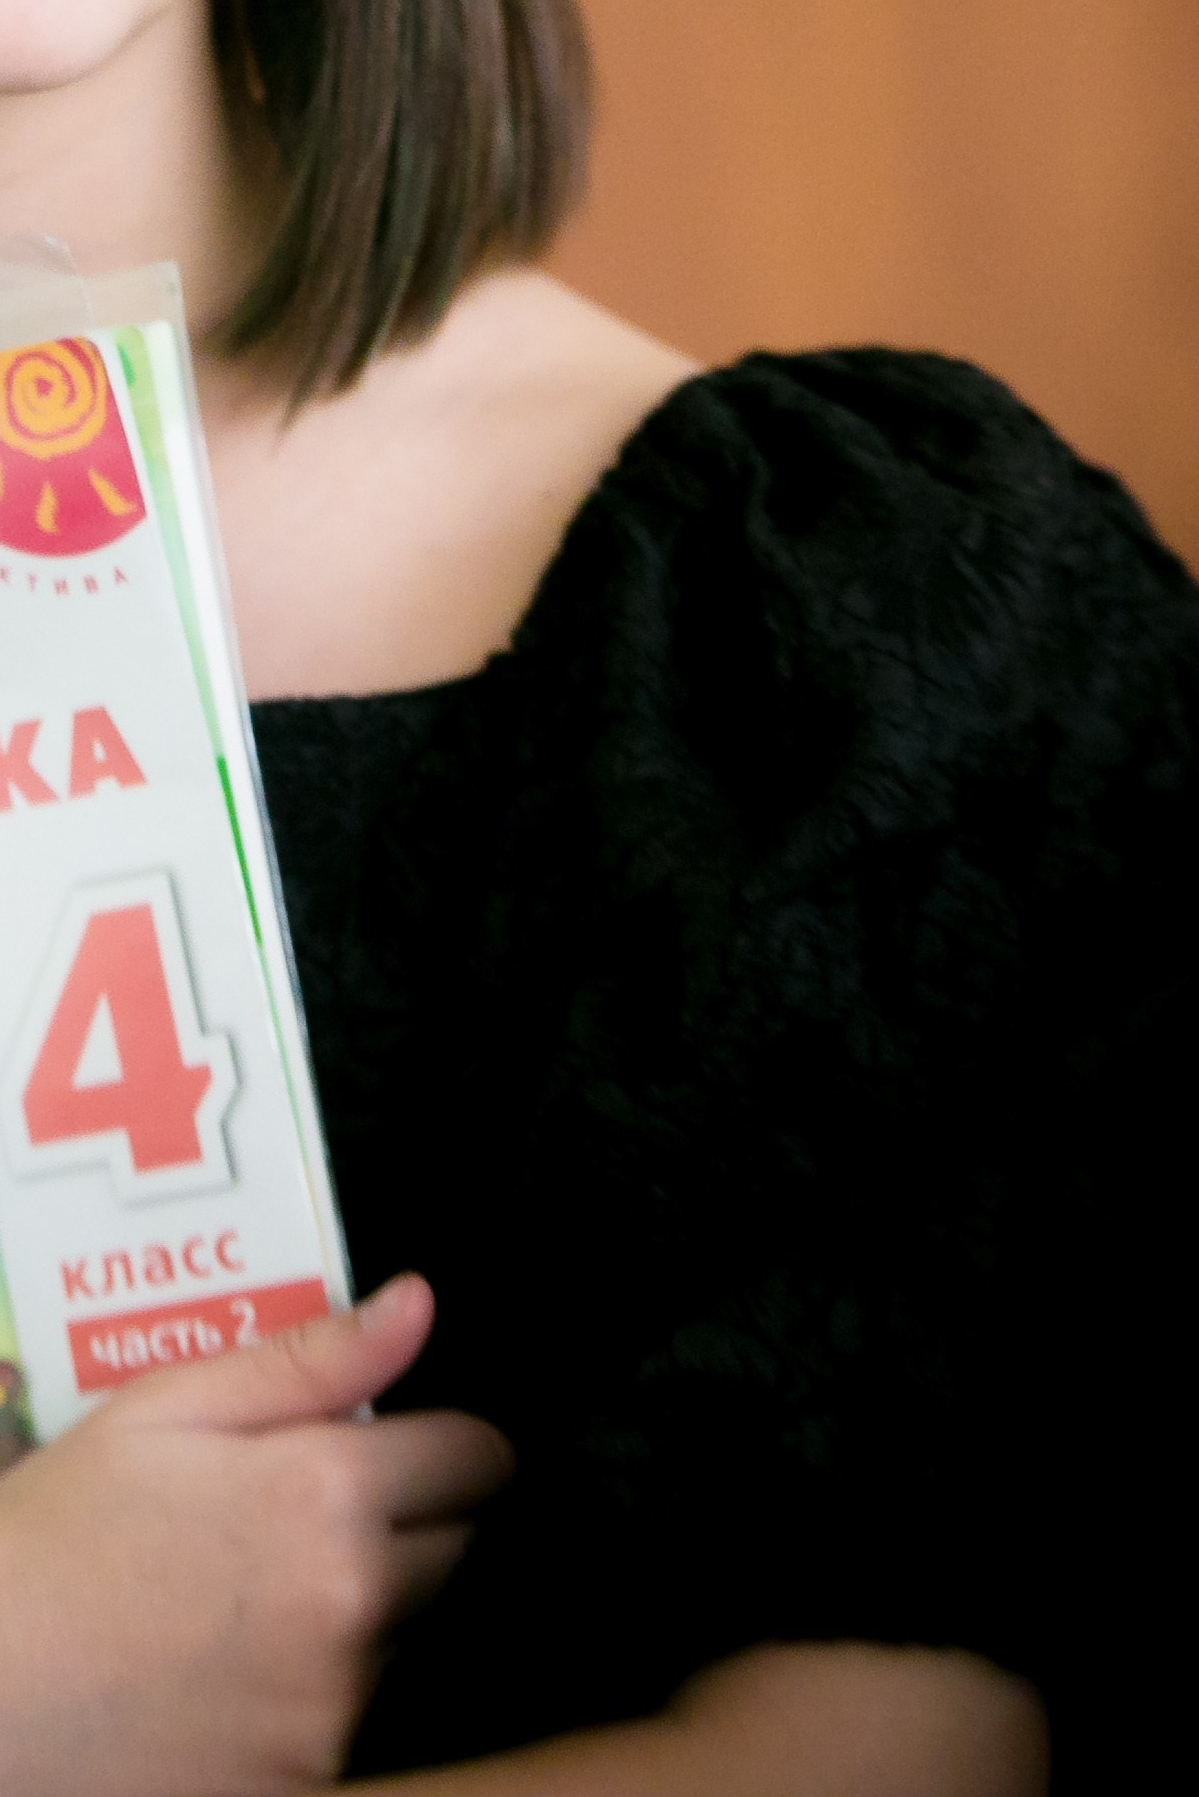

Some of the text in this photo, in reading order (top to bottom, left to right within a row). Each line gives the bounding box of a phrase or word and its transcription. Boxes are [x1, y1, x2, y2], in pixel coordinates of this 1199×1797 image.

[22, 901, 213, 1176] 4
[59, 1228, 246, 1303] класс
[89, 1298, 258, 1371] часть 2
